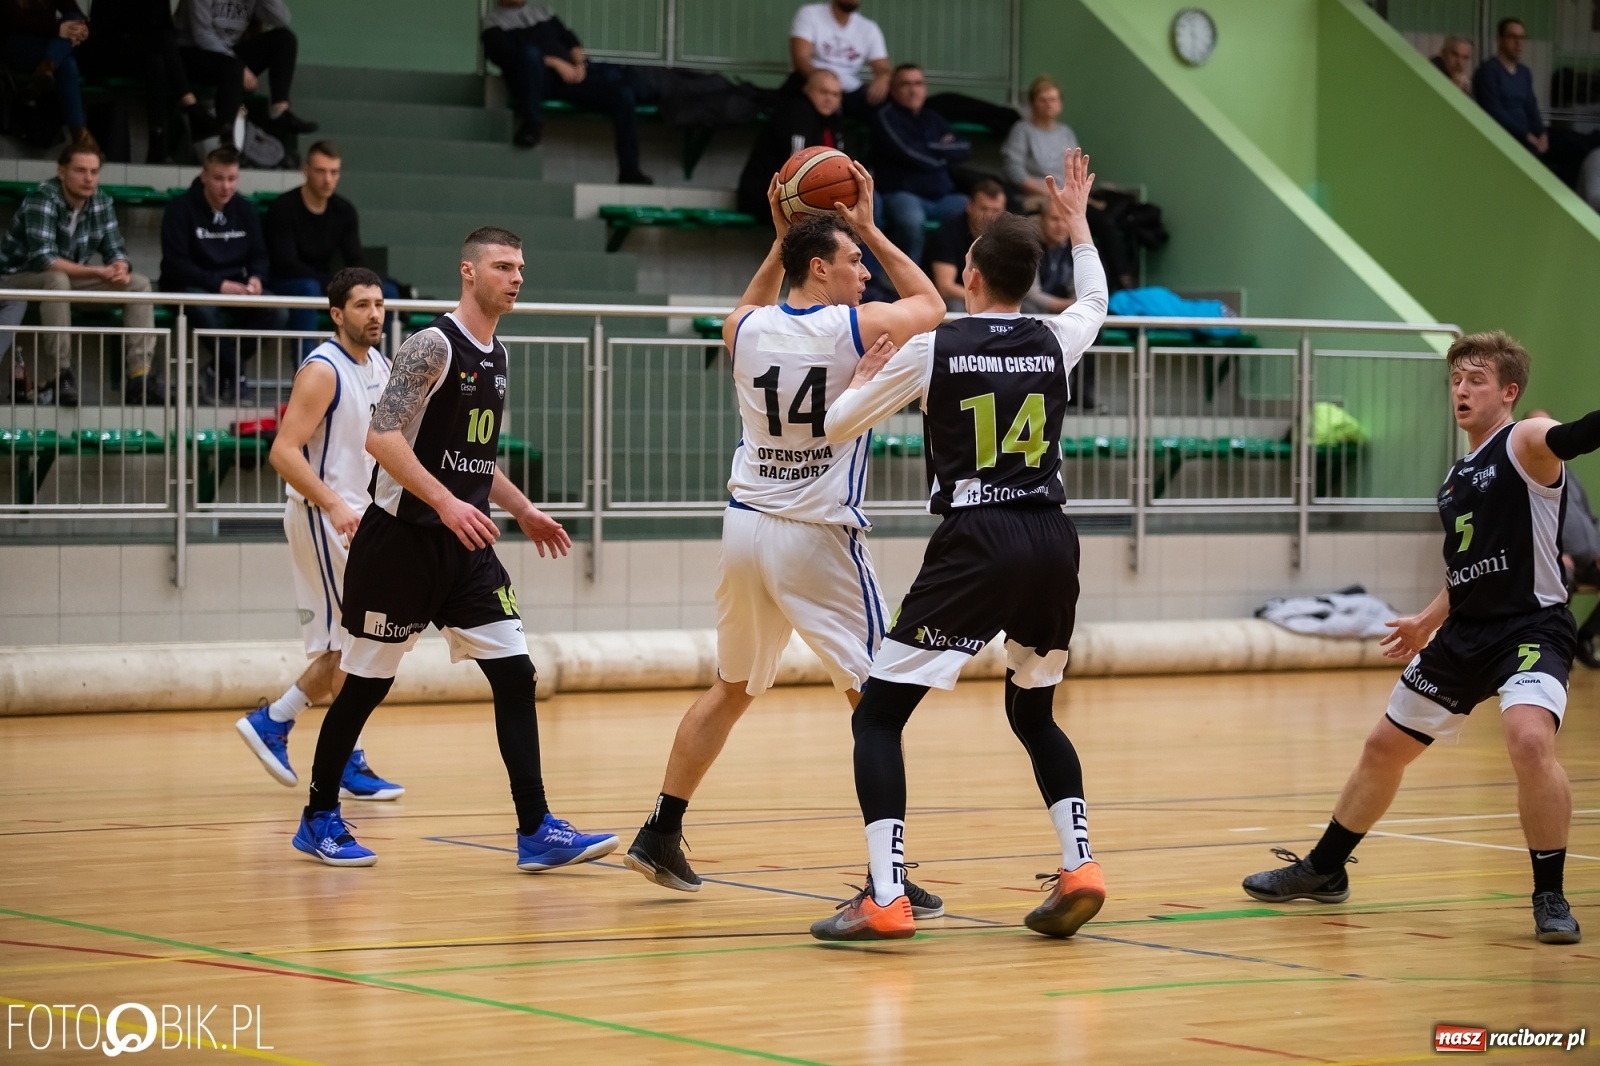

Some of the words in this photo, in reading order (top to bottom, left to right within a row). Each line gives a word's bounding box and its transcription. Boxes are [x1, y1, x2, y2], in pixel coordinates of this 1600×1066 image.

[949, 355, 1003, 374] NACOMI
[1006, 356, 1056, 373] CIESZYN
[753, 365, 828, 438] 14
[467, 408, 495, 445] 10
[960, 392, 1050, 471] 14
[441, 449, 495, 475] Nacom
[758, 445, 833, 463] OFENSYWA
[1455, 512, 1474, 553] 5
[919, 625, 986, 651] Nacom
[1517, 643, 1541, 672] 5
